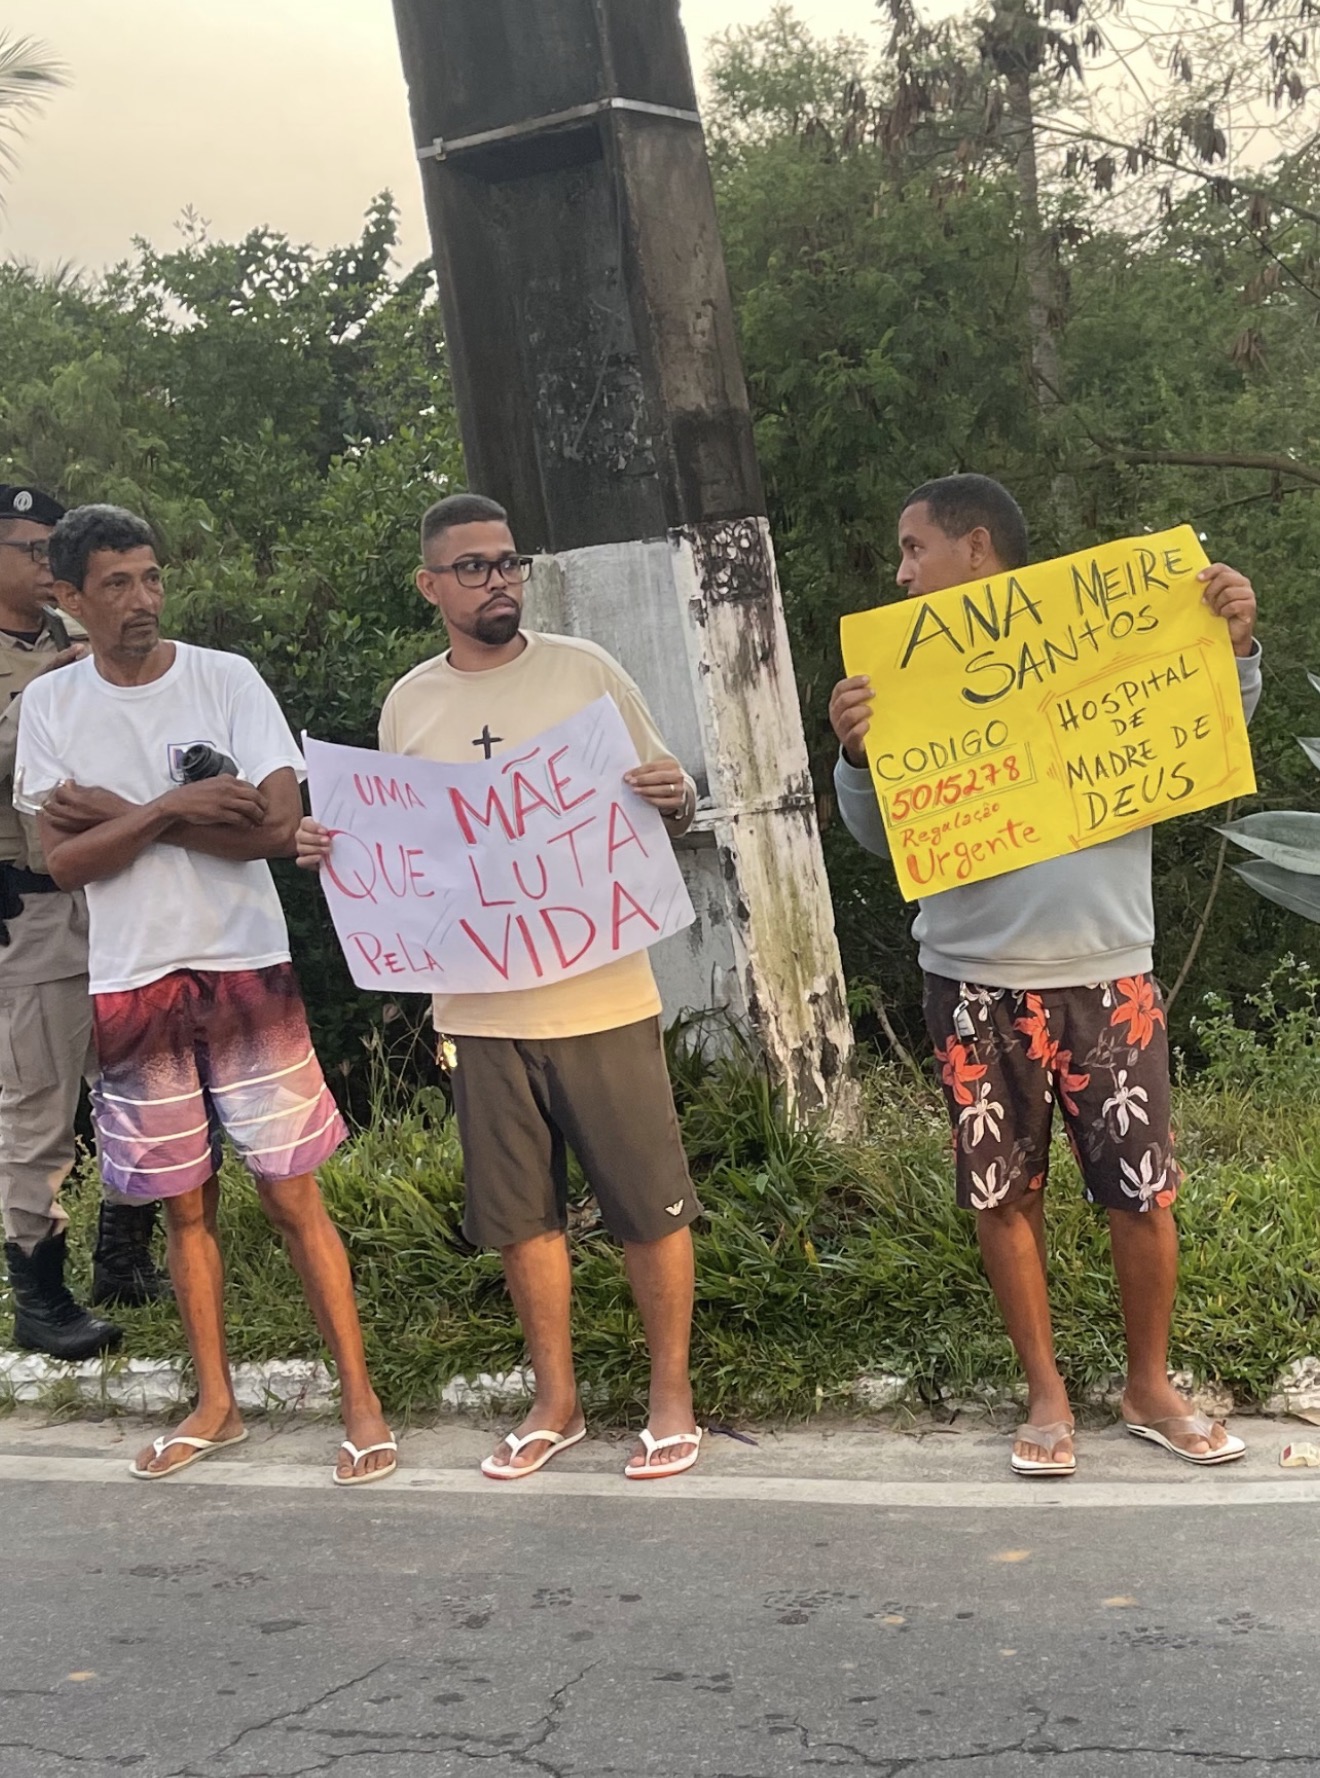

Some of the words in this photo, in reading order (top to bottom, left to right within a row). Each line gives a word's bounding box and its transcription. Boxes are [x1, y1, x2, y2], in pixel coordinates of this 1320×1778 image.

[900, 576, 1043, 669] ANA
[1071, 548, 1194, 620] MEIRE
[1056, 654, 1199, 731] HOSPITAL
[1113, 708, 1147, 737] DE
[876, 720, 1008, 782] CODIGO
[891, 755, 1021, 821] 5015278
[1066, 739, 1157, 789] MADRE
[1171, 714, 1211, 749] DE
[354, 774, 427, 810] UMA
[447, 745, 596, 845] MÃE
[1083, 762, 1195, 830] DEUS
[323, 829, 435, 904] QUE
[468, 802, 649, 907] LUTA
[906, 820, 1041, 884] Urgente
[347, 932, 444, 976] PELA
[460, 881, 660, 980] VIDA
